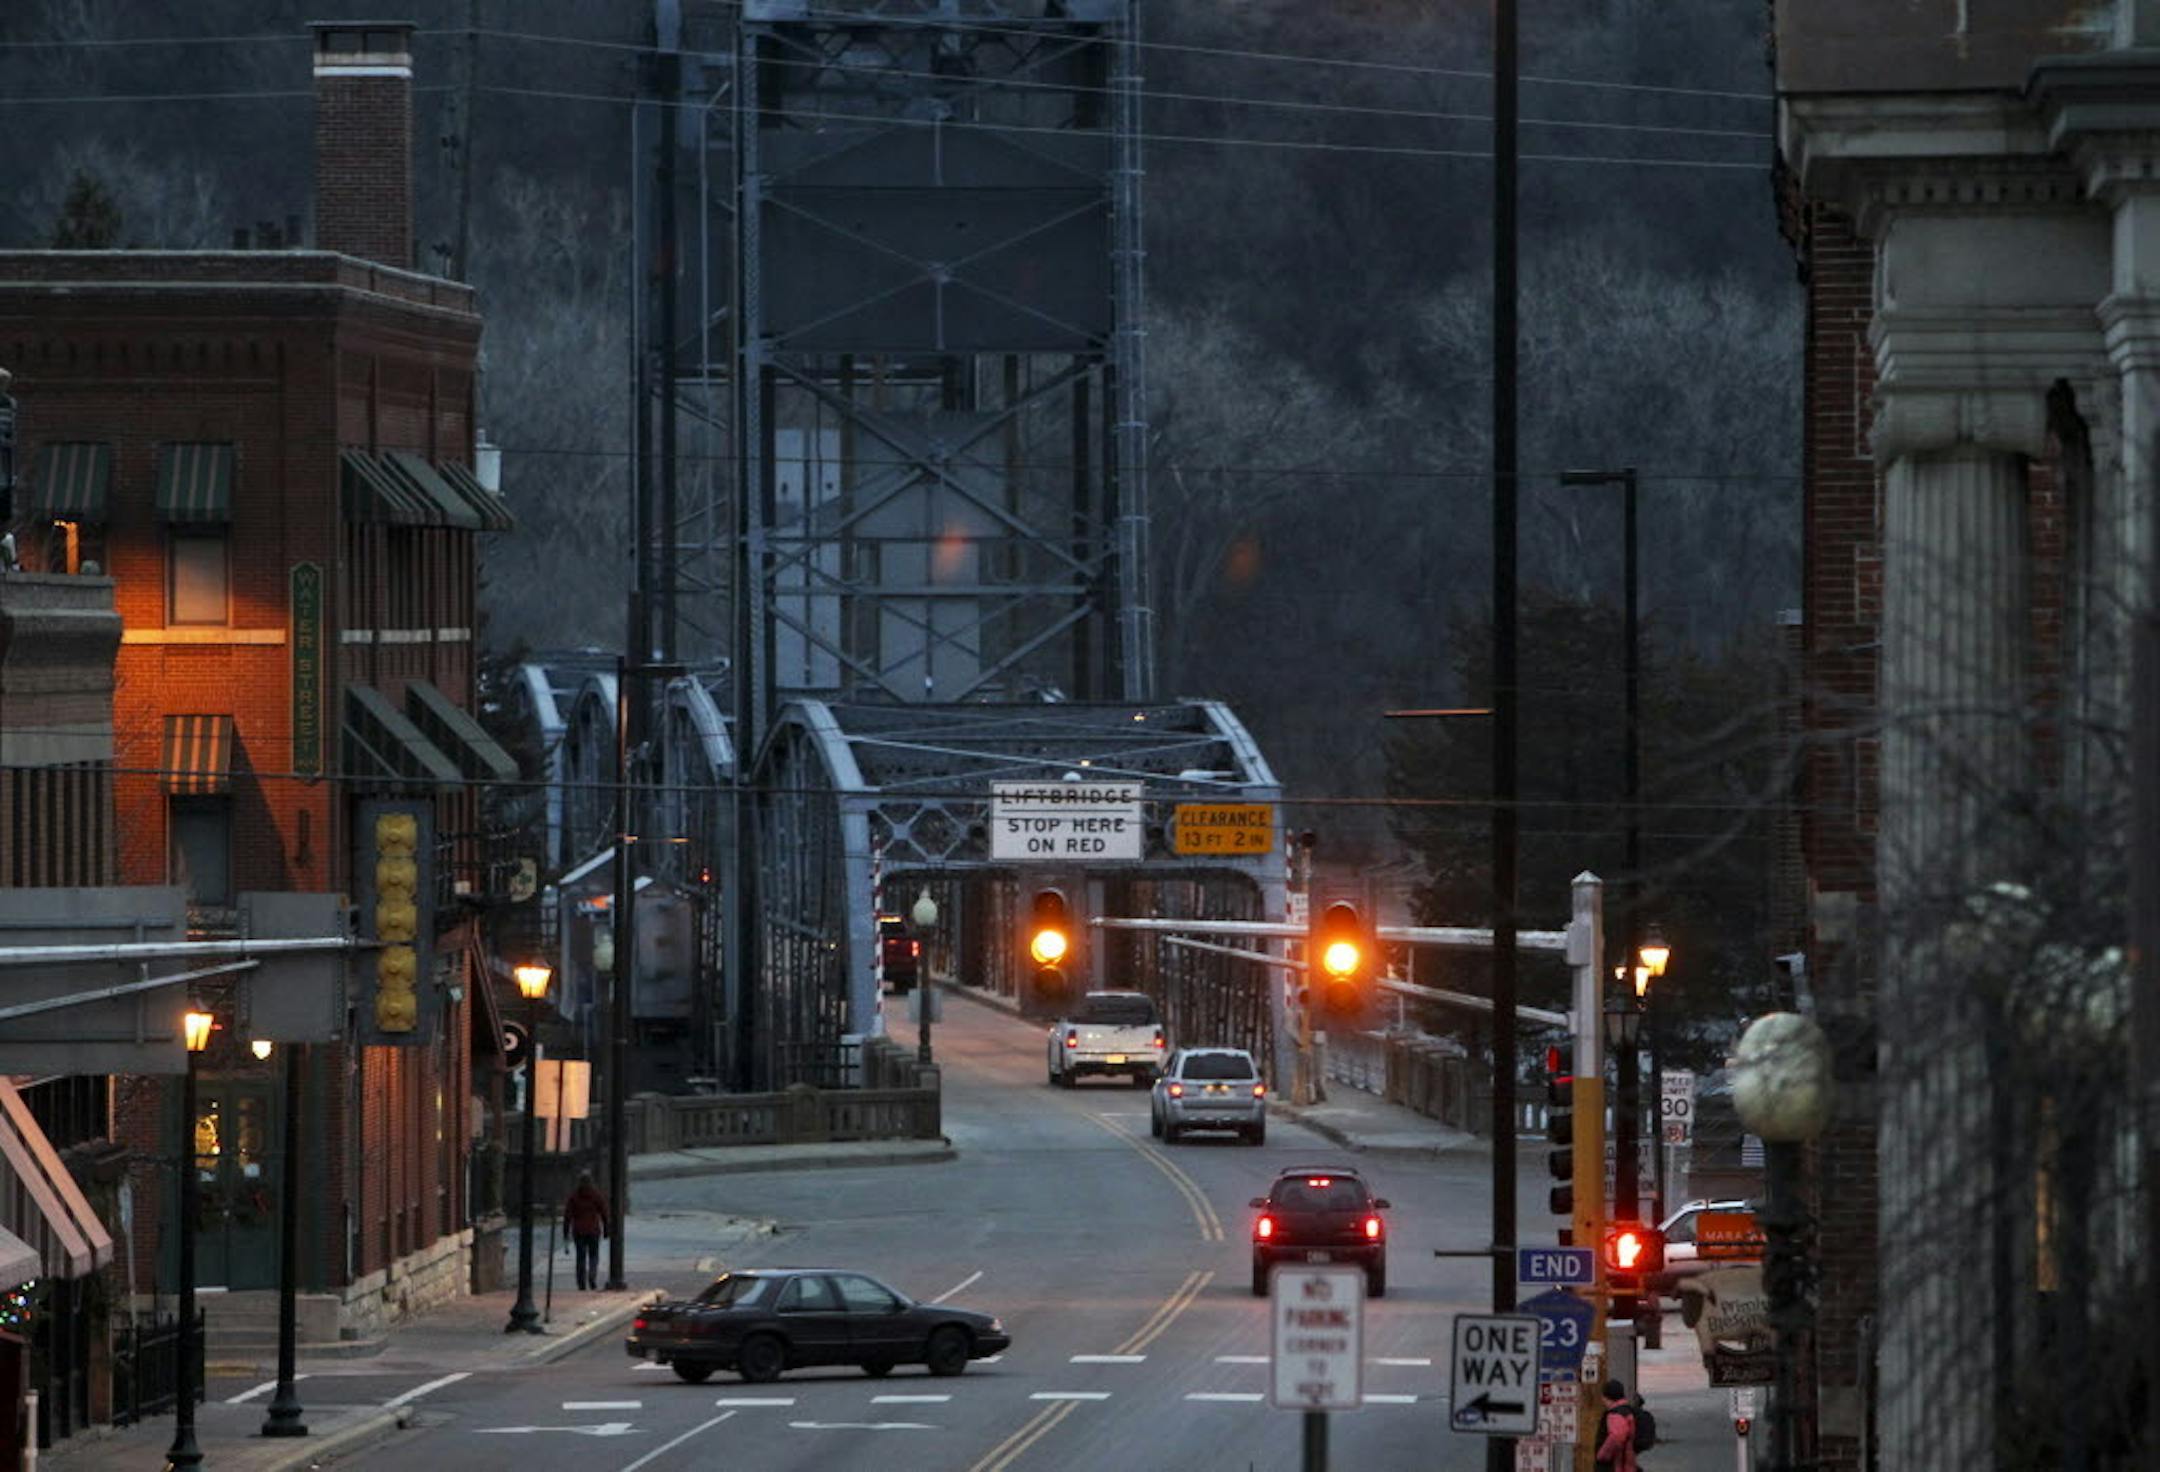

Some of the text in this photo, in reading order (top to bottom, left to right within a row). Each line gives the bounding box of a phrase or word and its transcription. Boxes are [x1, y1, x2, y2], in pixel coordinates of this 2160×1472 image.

[299, 571, 317, 751] WATER STREET
[1001, 789, 1132, 804] LIFTBRIDGE
[1008, 818, 1124, 832] STOP HERE
[1181, 811, 1266, 826] CLEARANCE
[1027, 838, 1105, 852] ON RED
[1185, 831, 1265, 846] 13 FT 2 IN
[1661, 1098, 1688, 1115] 30
[1531, 1256, 1581, 1277] END
[1465, 1325, 1529, 1354] ONE
[1540, 1317, 1579, 1347] 23
[1463, 1359, 1529, 1387] WAY
